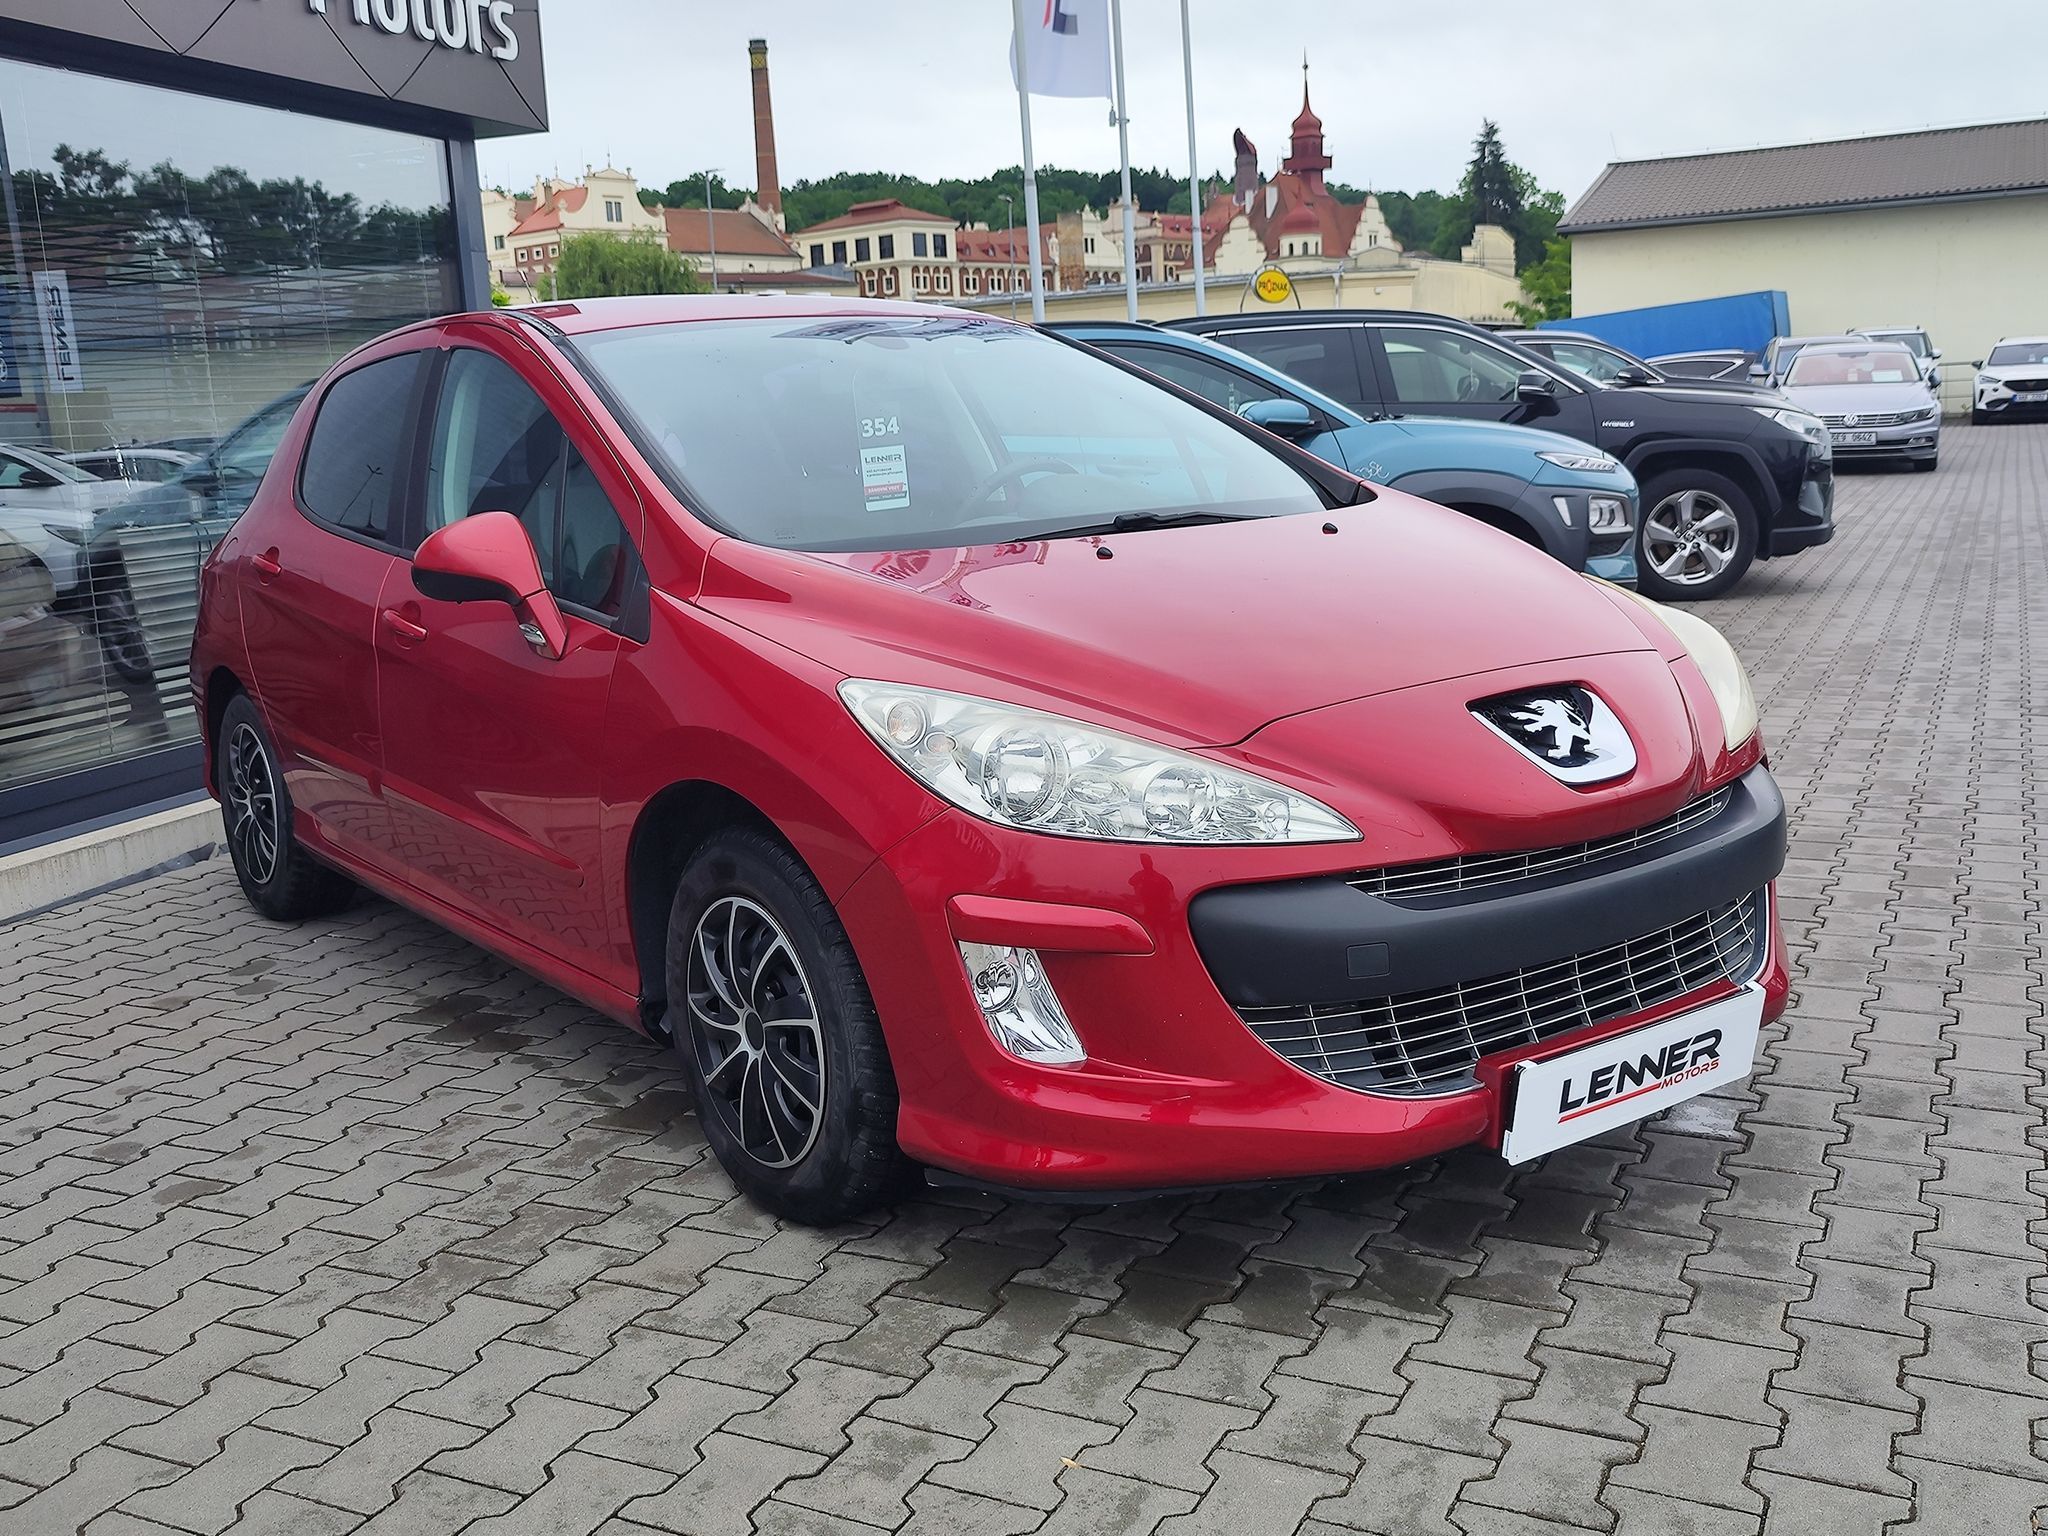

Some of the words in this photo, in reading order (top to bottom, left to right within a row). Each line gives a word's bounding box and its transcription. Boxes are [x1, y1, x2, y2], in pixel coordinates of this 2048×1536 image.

[308, 0, 520, 62] otors
[860, 415, 900, 438] 354
[864, 453, 903, 464] LENNER
[1558, 1028, 1723, 1113] LENNER
[1660, 1058, 1720, 1090] MOTORS
